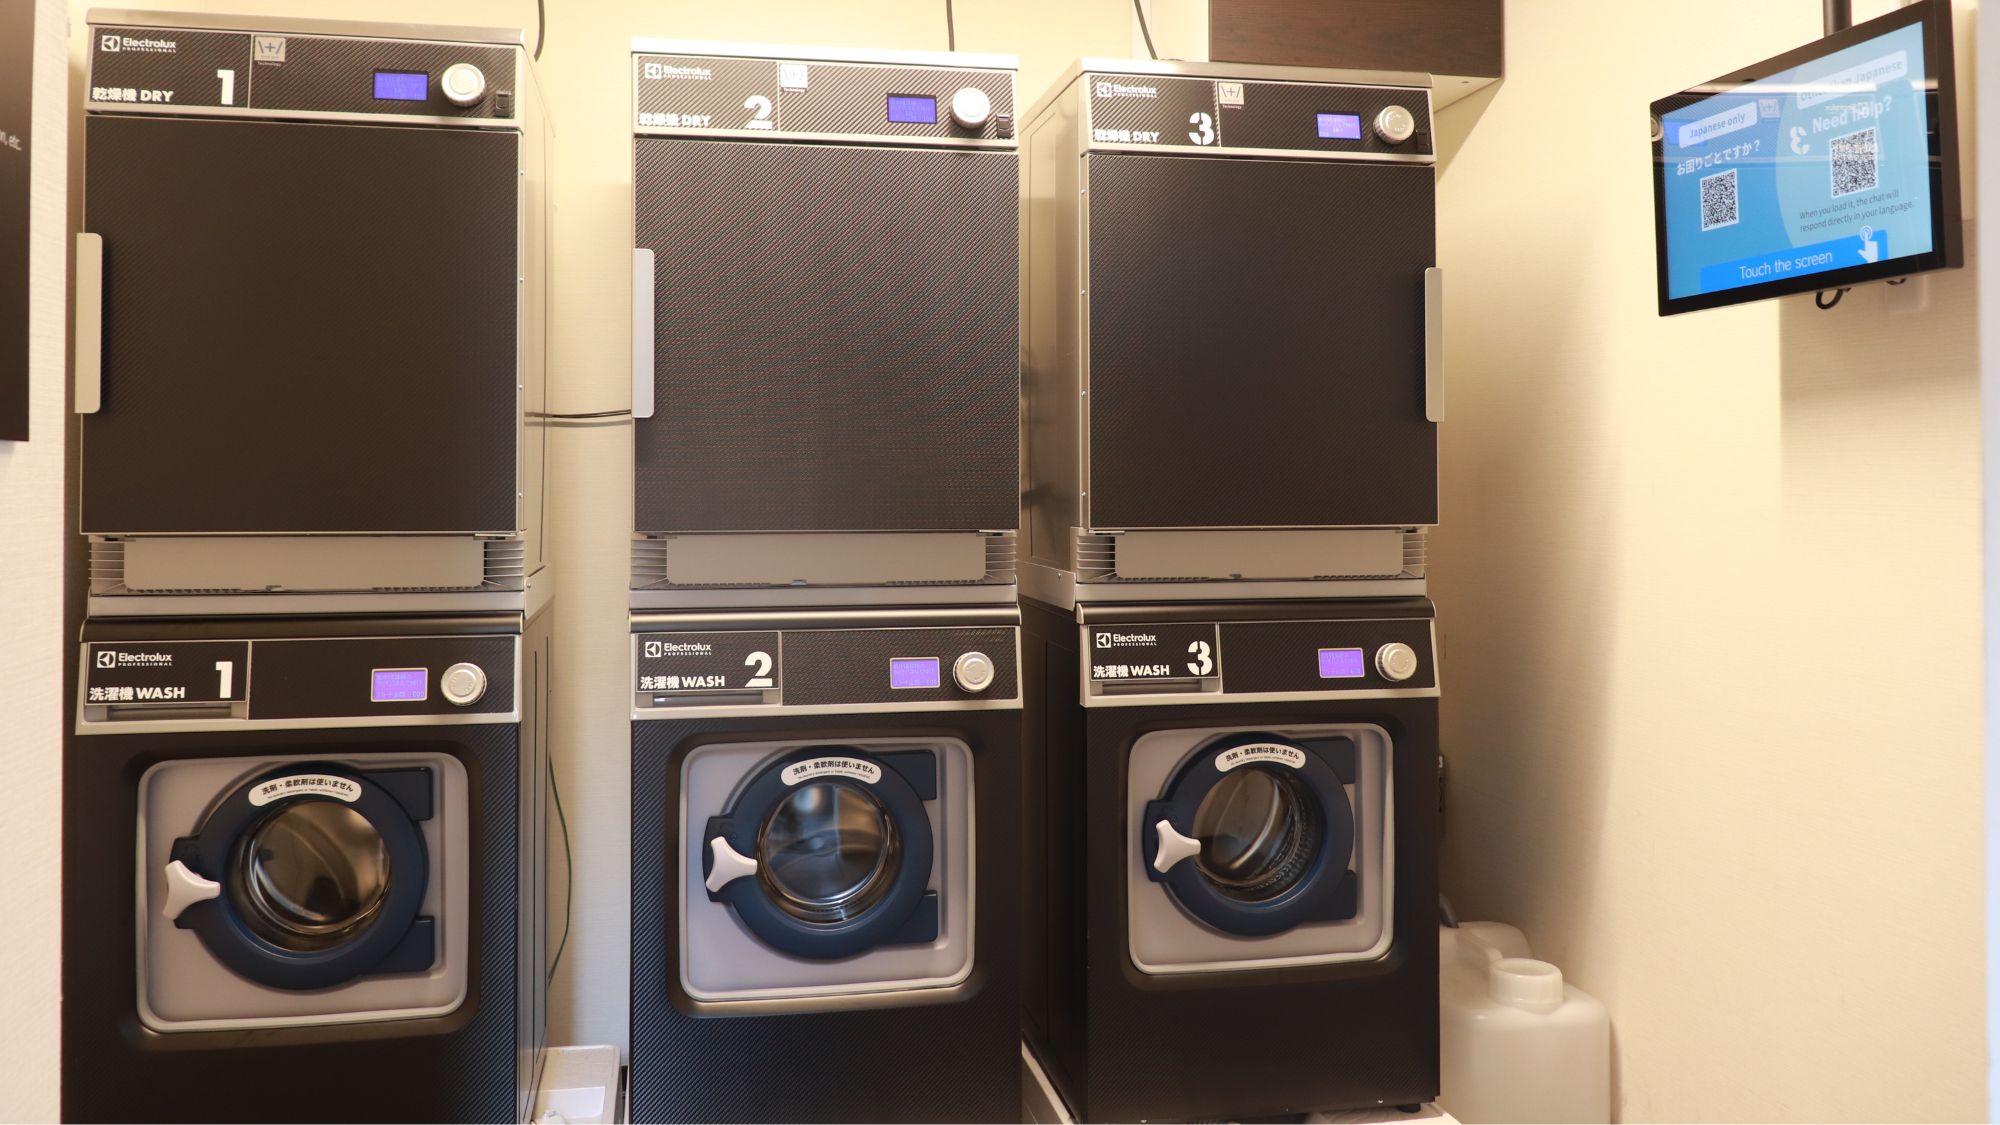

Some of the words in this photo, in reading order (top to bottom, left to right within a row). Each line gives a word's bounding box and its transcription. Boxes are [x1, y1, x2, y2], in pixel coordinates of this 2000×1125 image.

[122, 38, 176, 49] Electrolux
[663, 65, 711, 76] Electrolux
[1856, 61, 1903, 84] Japanese
[217, 69, 235, 105] 1
[1113, 84, 1157, 94] Electrolux
[140, 90, 174, 102] DRY
[682, 114, 711, 127] DRY
[744, 95, 772, 130] 2
[1812, 109, 1848, 134] Need
[1852, 95, 1893, 122] help?
[1188, 112, 1214, 146] 3
[1689, 120, 1727, 139] Japanese
[1728, 112, 1746, 126] only
[1132, 131, 1160, 143] DRY
[1800, 209, 1818, 219] When
[1818, 207, 1831, 218] you
[1856, 198, 1868, 207] the
[1869, 193, 1885, 204] chat
[1886, 189, 1899, 200] will
[1800, 219, 1827, 232] respond
[1827, 213, 1853, 226] directly
[1861, 208, 1878, 220] your
[1740, 262, 1772, 279] Touch
[1775, 258, 1792, 272] the
[1795, 251, 1833, 269] screen
[1113, 634, 1157, 643] Electrolux
[664, 643, 712, 652] Electrolux
[119, 652, 173, 662] Electrolux
[1187, 641, 1213, 676] 3
[745, 651, 773, 687] 2
[1093, 665, 1129, 678] 洗濯機
[1130, 665, 1170, 676] WASH
[216, 661, 233, 699] 1
[640, 676, 680, 690] 洗濯機
[682, 676, 725, 688] WASH
[90, 687, 133, 701] 洗濯機
[136, 687, 185, 699] WASH
[793, 760, 875, 776] 洗剤・柔軟剤は使いません
[262, 778, 354, 796] 洗剤・柔軟剤は使いません
